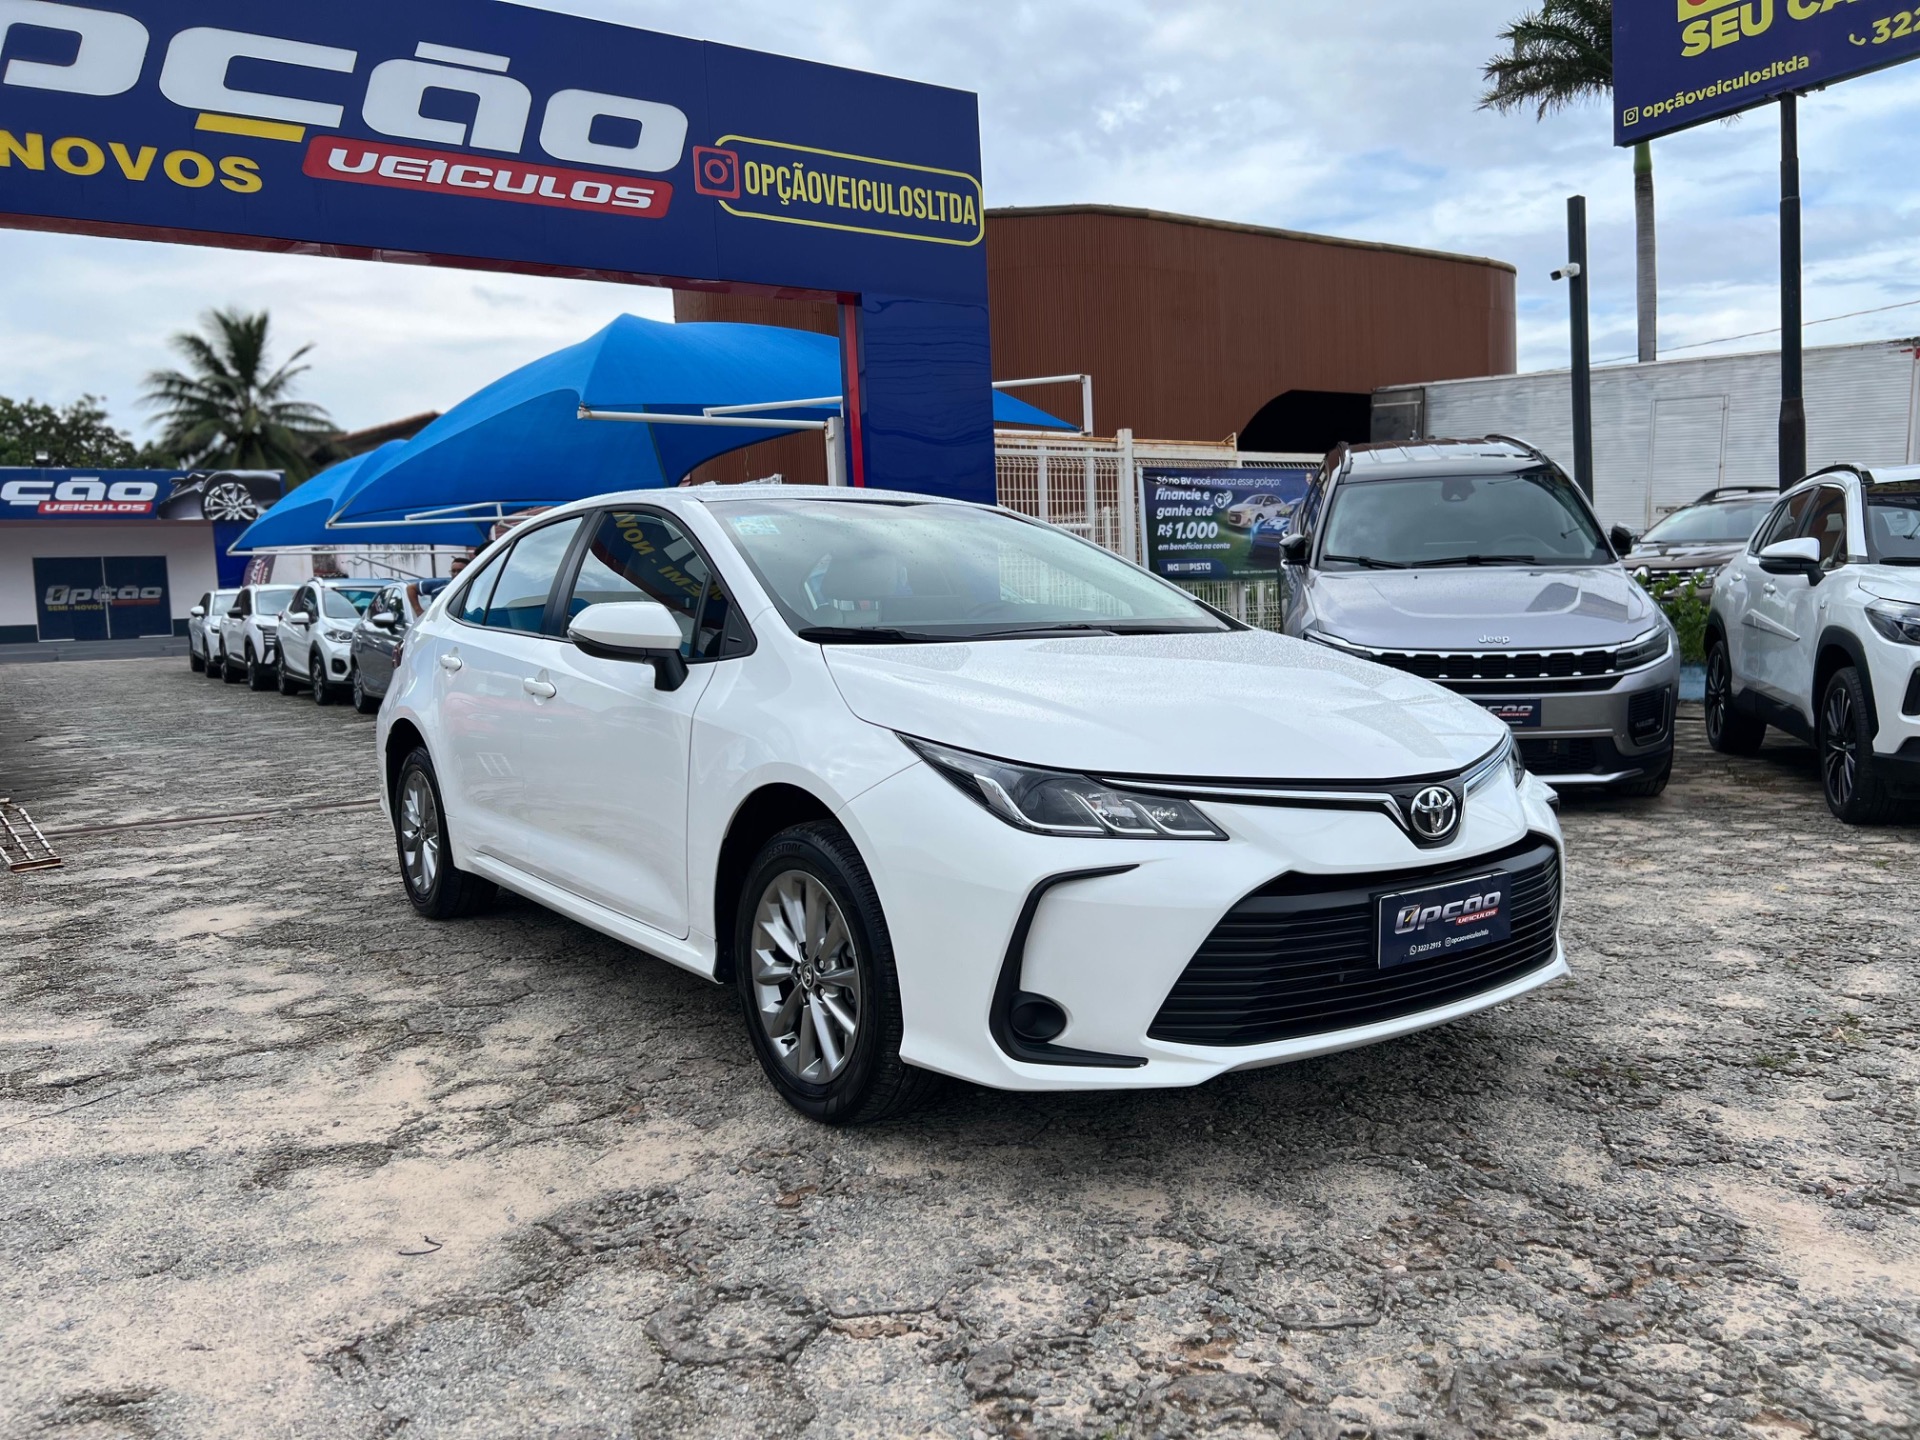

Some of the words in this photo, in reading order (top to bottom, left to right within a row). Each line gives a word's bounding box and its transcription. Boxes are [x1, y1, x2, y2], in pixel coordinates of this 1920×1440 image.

[1681, 0, 1773, 57] SEU
[1872, 6, 1920, 44] 32
[1642, 55, 1809, 118] opçãoveiculosltda
[0, 129, 263, 193] NOVOS
[745, 162, 977, 226] OPÇÃOVEICULOSLTDA
[1181, 477, 1192, 485] BV
[1192, 476, 1211, 486] você
[1211, 478, 1237, 486] marca
[1238, 478, 1254, 486] esse
[1155, 488, 1202, 500] financie
[1203, 491, 1210, 500] e
[1156, 504, 1194, 520] ganhe
[1194, 504, 1214, 517] até
[1157, 522, 1173, 538] R$
[1175, 521, 1219, 540] 1.000
[1213, 542, 1231, 550] conta
[1478, 634, 1510, 644] Jeep
